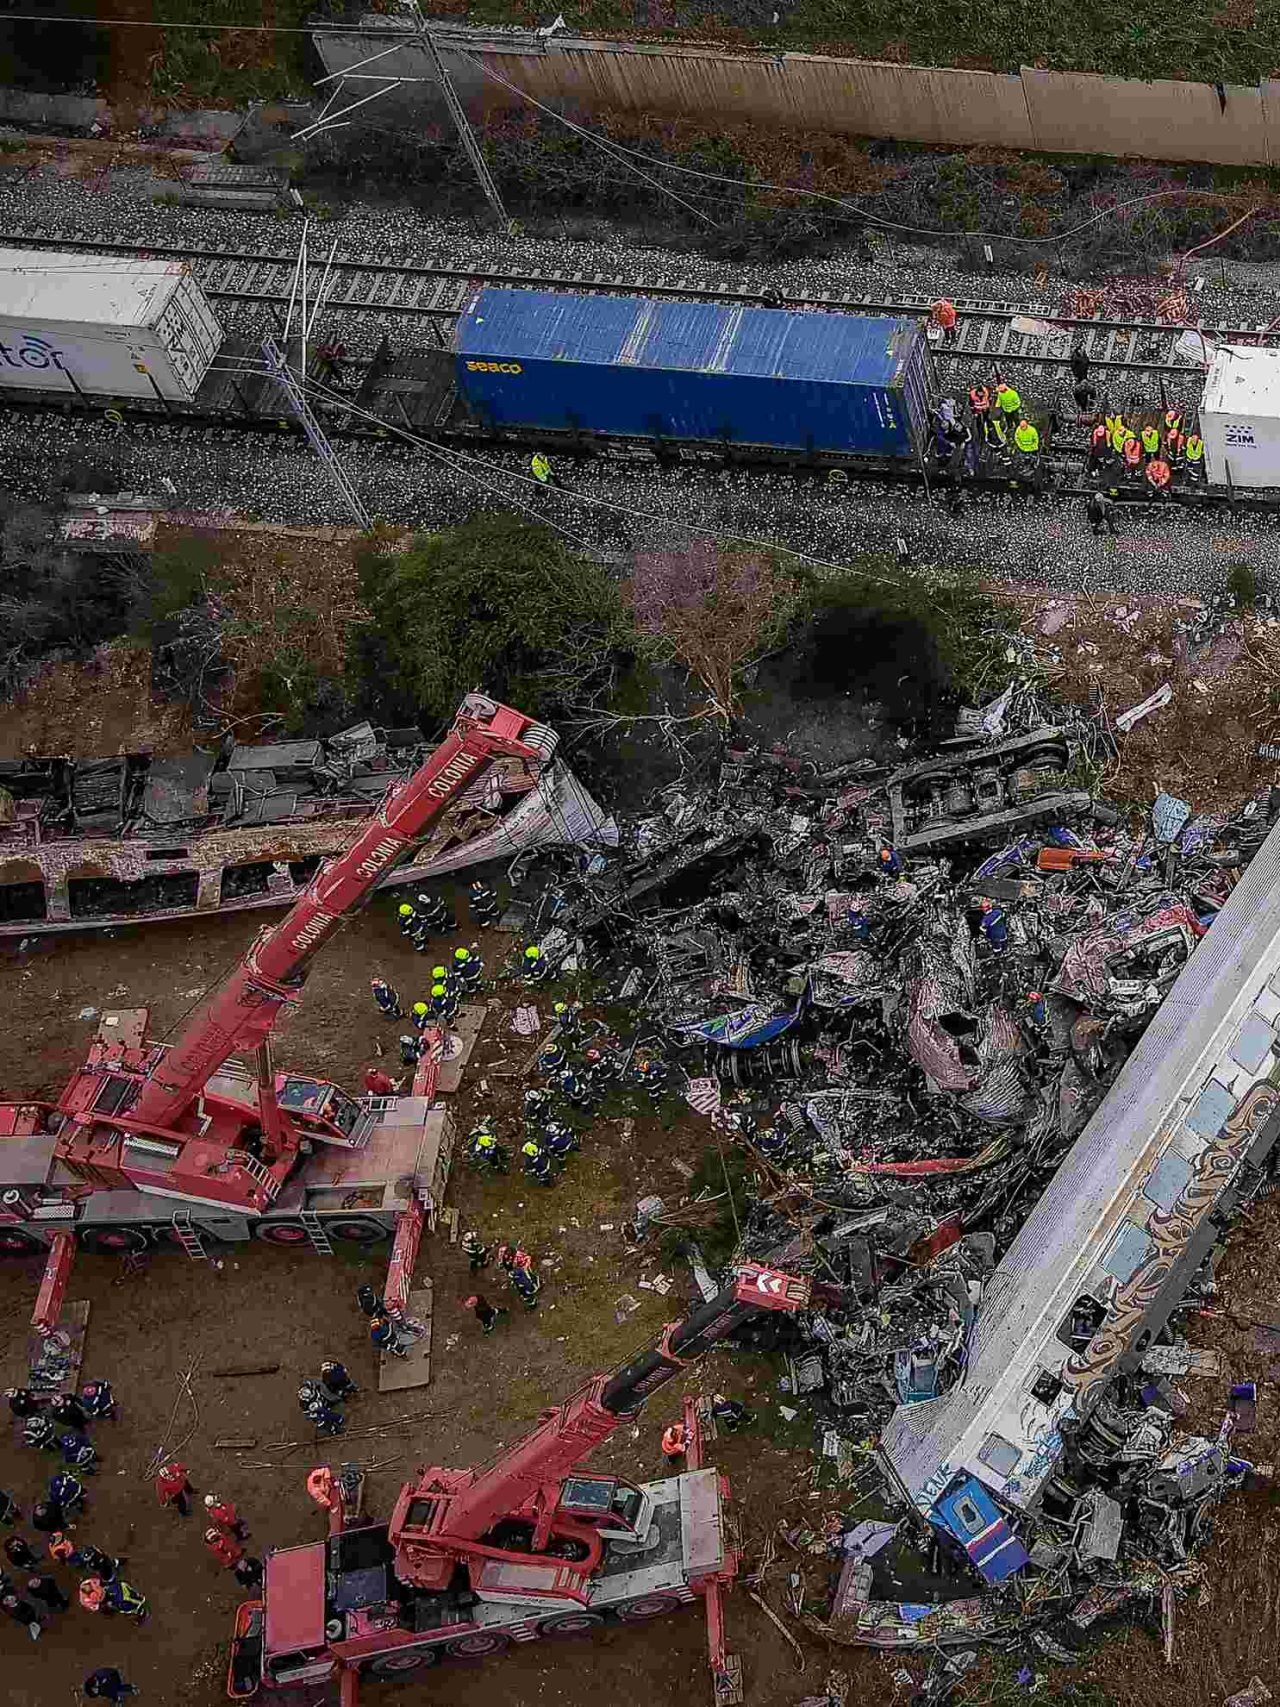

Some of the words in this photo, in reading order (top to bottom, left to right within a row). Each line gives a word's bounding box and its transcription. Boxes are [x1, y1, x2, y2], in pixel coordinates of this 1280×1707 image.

[465, 361, 524, 374] seaco
[1226, 434, 1255, 444] ZIM
[428, 752, 478, 798] COLONIA
[356, 837, 402, 878] COLONIA
[292, 912, 334, 950] COLONIA
